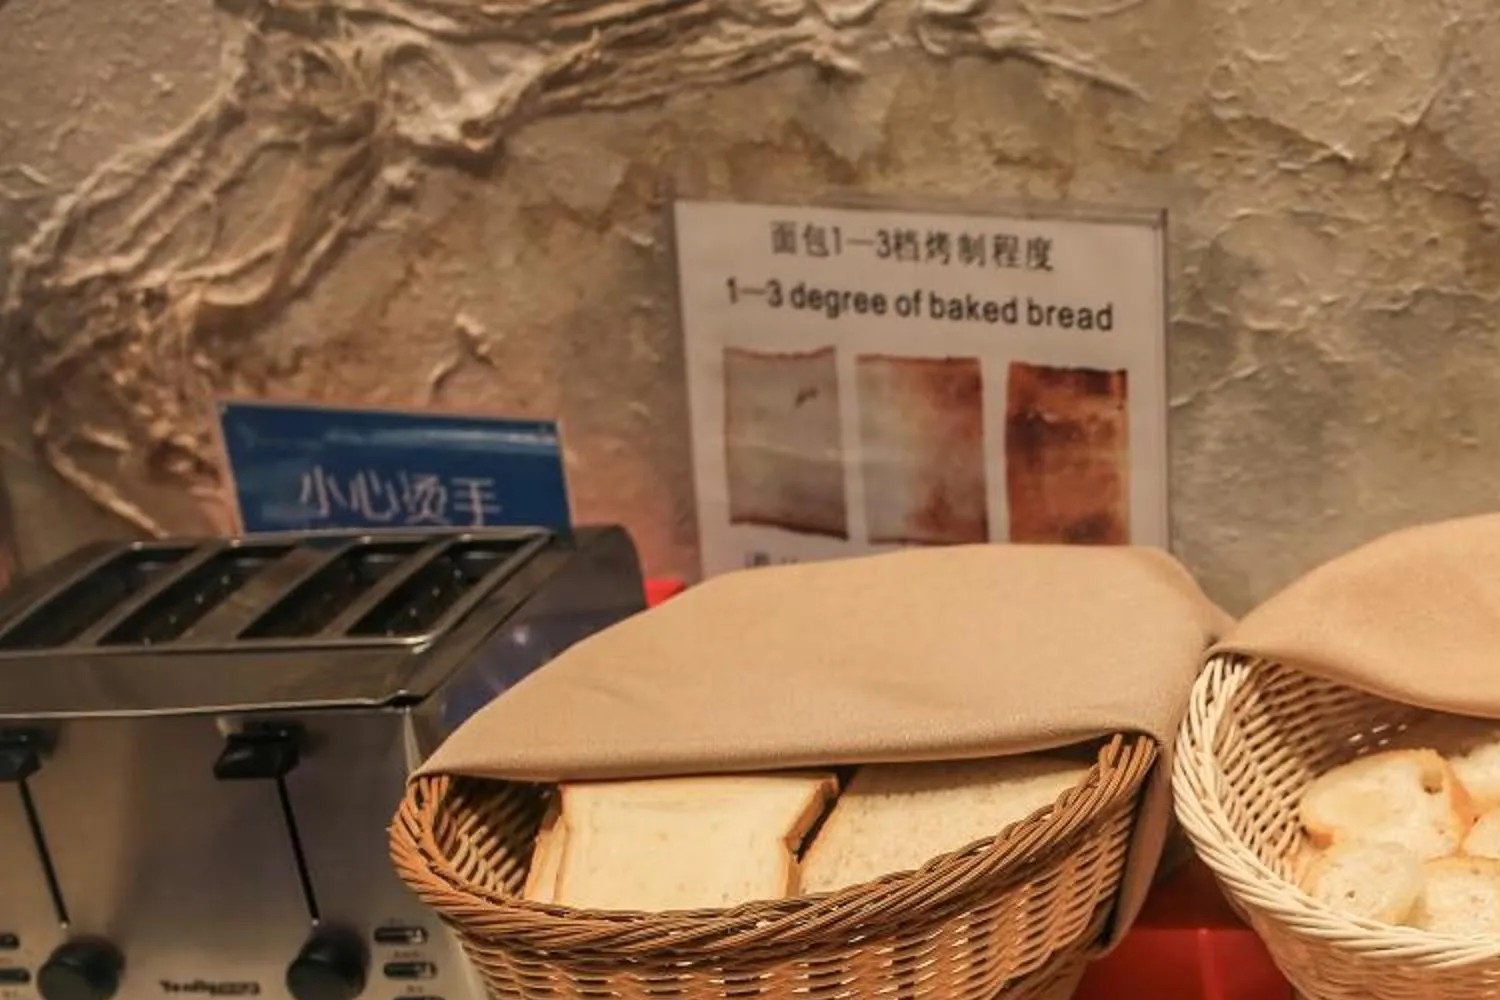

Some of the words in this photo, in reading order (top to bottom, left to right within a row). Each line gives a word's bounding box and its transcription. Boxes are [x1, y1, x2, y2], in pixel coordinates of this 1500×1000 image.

[789, 281, 888, 320] degree
[895, 289, 922, 318] of
[929, 290, 1019, 323] baked
[1026, 297, 1114, 332] bread
[301, 464, 502, 527] 小心烫手
